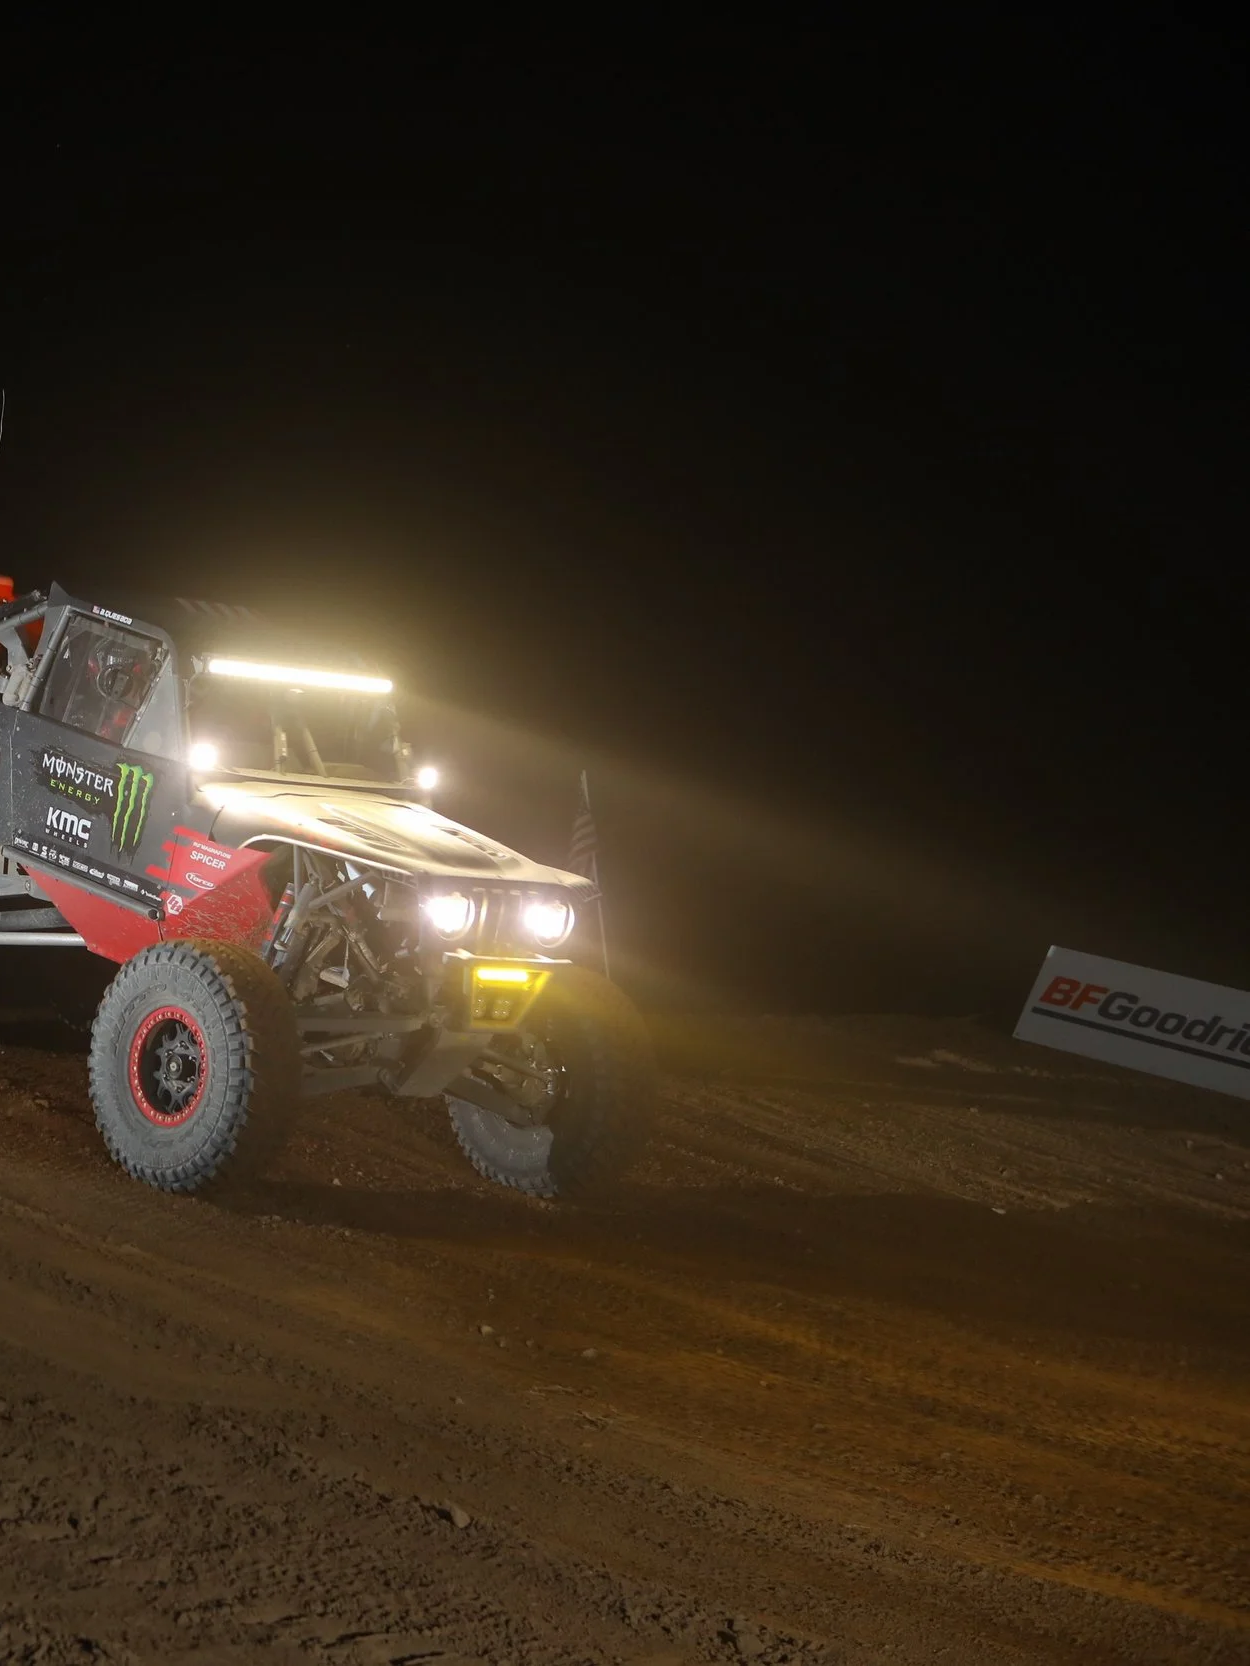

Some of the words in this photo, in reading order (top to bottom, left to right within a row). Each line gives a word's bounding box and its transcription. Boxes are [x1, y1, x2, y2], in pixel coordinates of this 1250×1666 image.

[42, 753, 114, 797] MONSTER
[50, 779, 100, 805] ENERGY
[46, 806, 92, 841] KMC
[45, 829, 88, 849] WHEELS
[190, 850, 226, 870] SPICER
